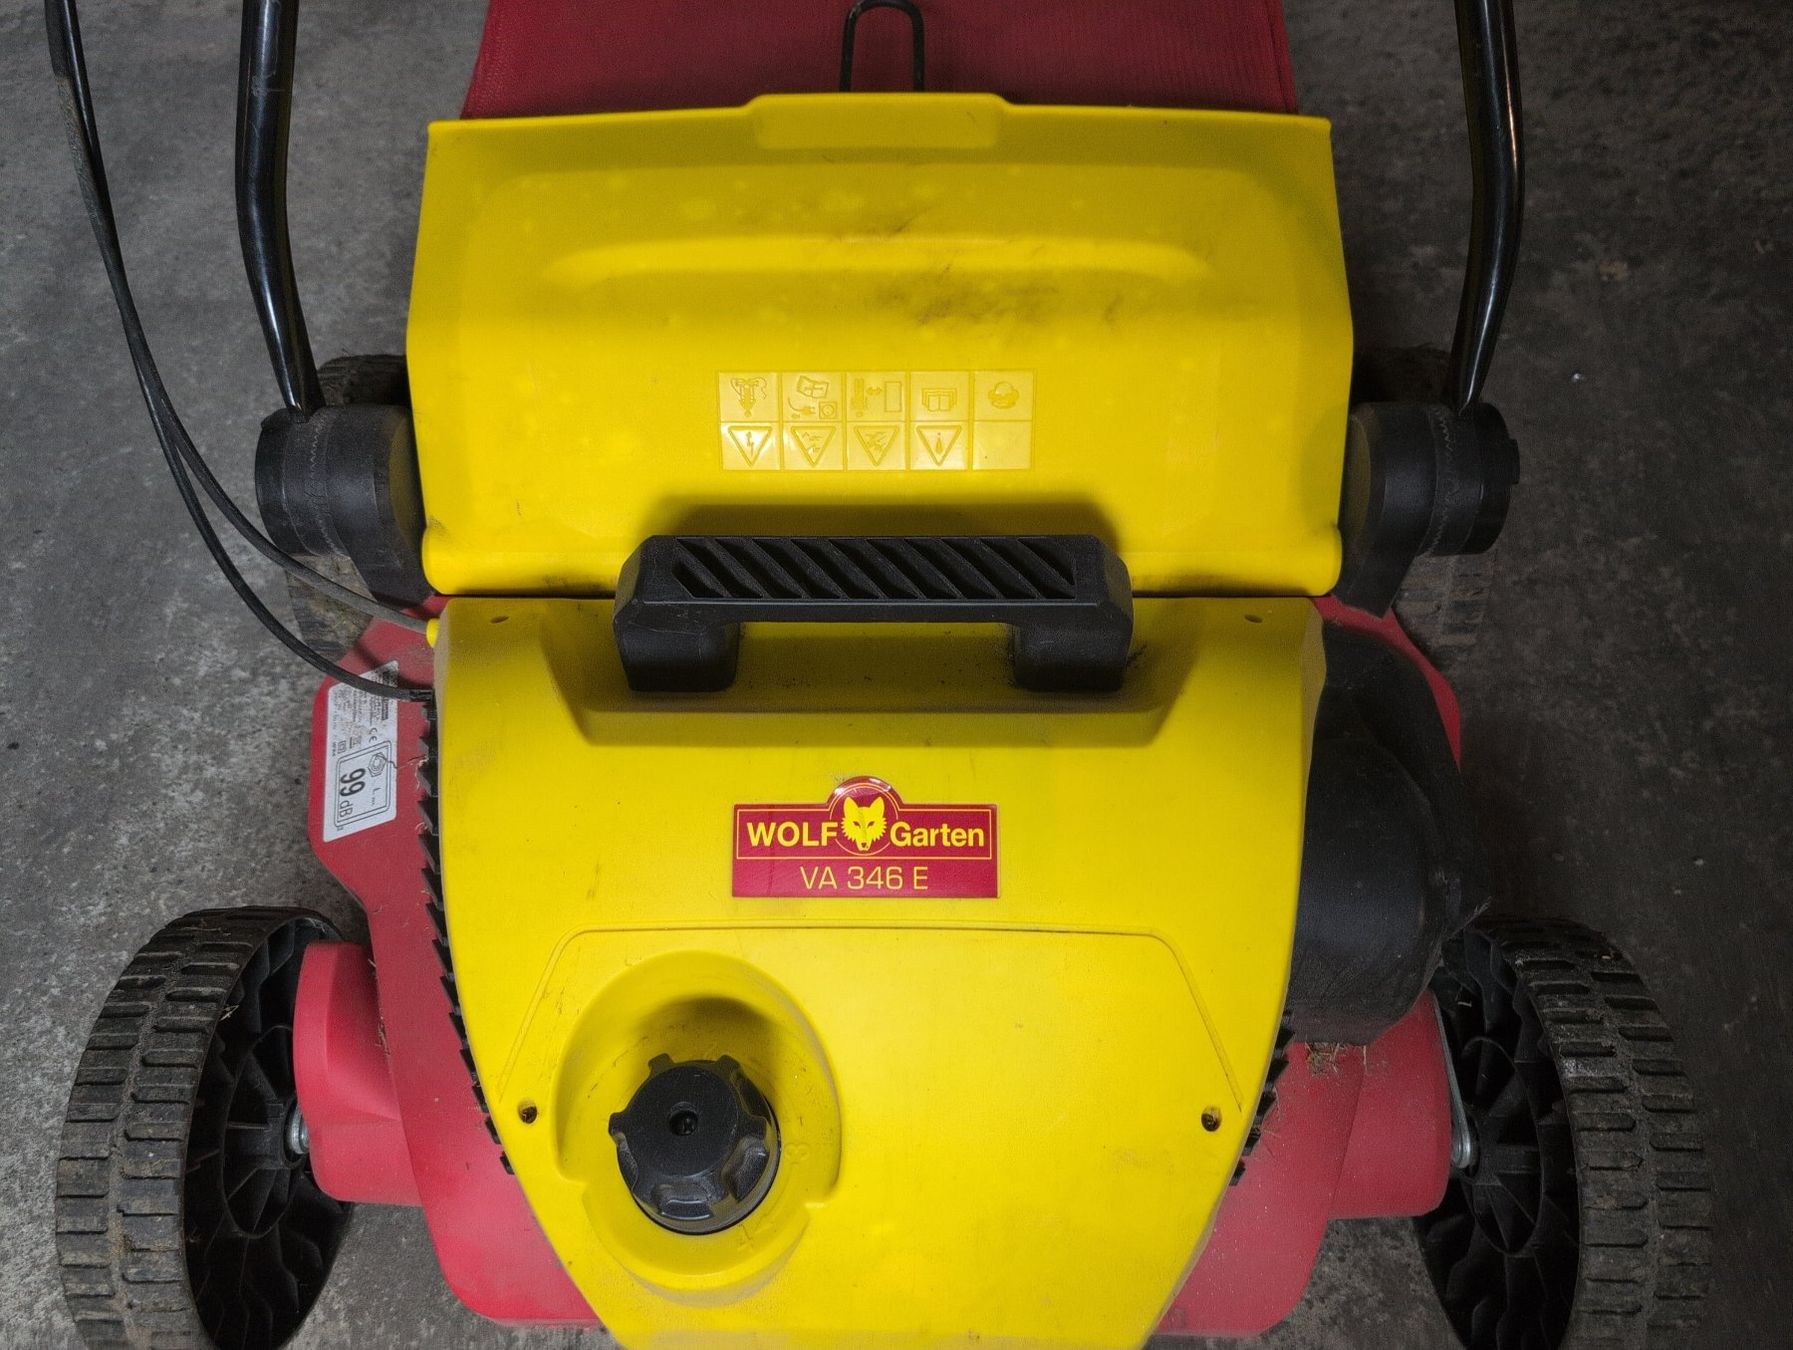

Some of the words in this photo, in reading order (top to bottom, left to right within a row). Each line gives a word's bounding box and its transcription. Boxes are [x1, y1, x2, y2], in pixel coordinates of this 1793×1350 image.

[339, 768, 366, 797] 99
[339, 800, 353, 818] dB
[746, 821, 839, 847] WOLF
[890, 821, 985, 847] Garten
[800, 866, 838, 890] VA
[847, 866, 903, 890] 346
[913, 866, 929, 890] E
